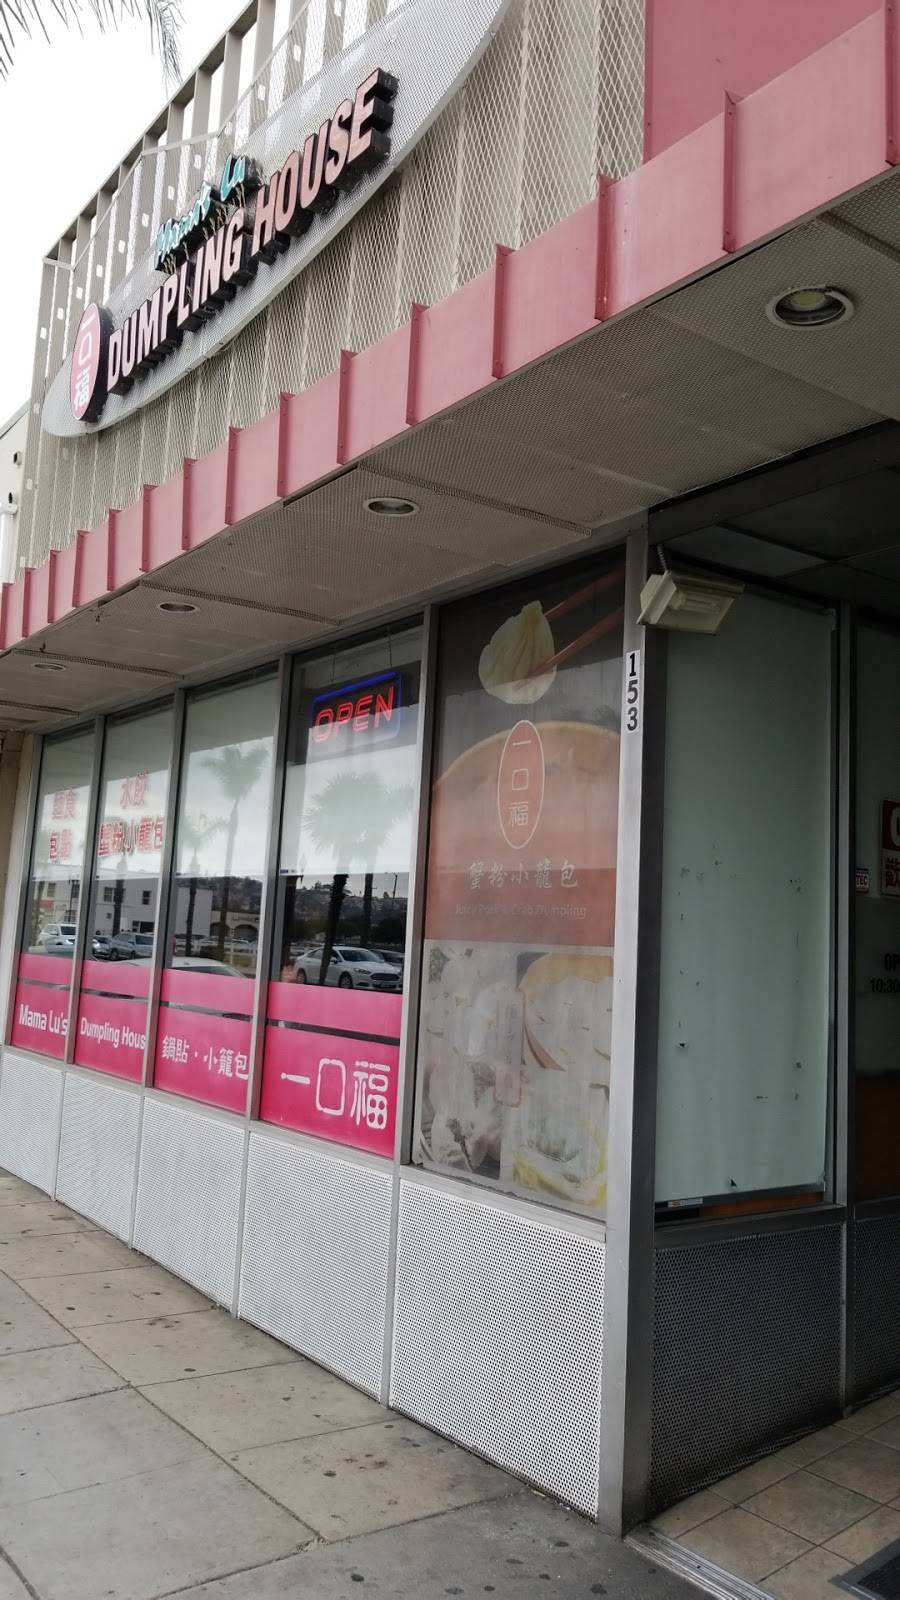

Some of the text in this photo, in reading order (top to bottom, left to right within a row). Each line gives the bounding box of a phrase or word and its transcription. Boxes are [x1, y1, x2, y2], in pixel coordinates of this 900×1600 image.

[107, 68, 381, 392] DUMPLING HOUSE
[313, 685, 395, 743] OPEN
[627, 652, 639, 731] 153
[508, 739, 532, 827] 一口福
[19, 1004, 68, 1036] Mama Lu's
[80, 1017, 120, 1048] Dumpling
[281, 1057, 391, 1130] 一口福
